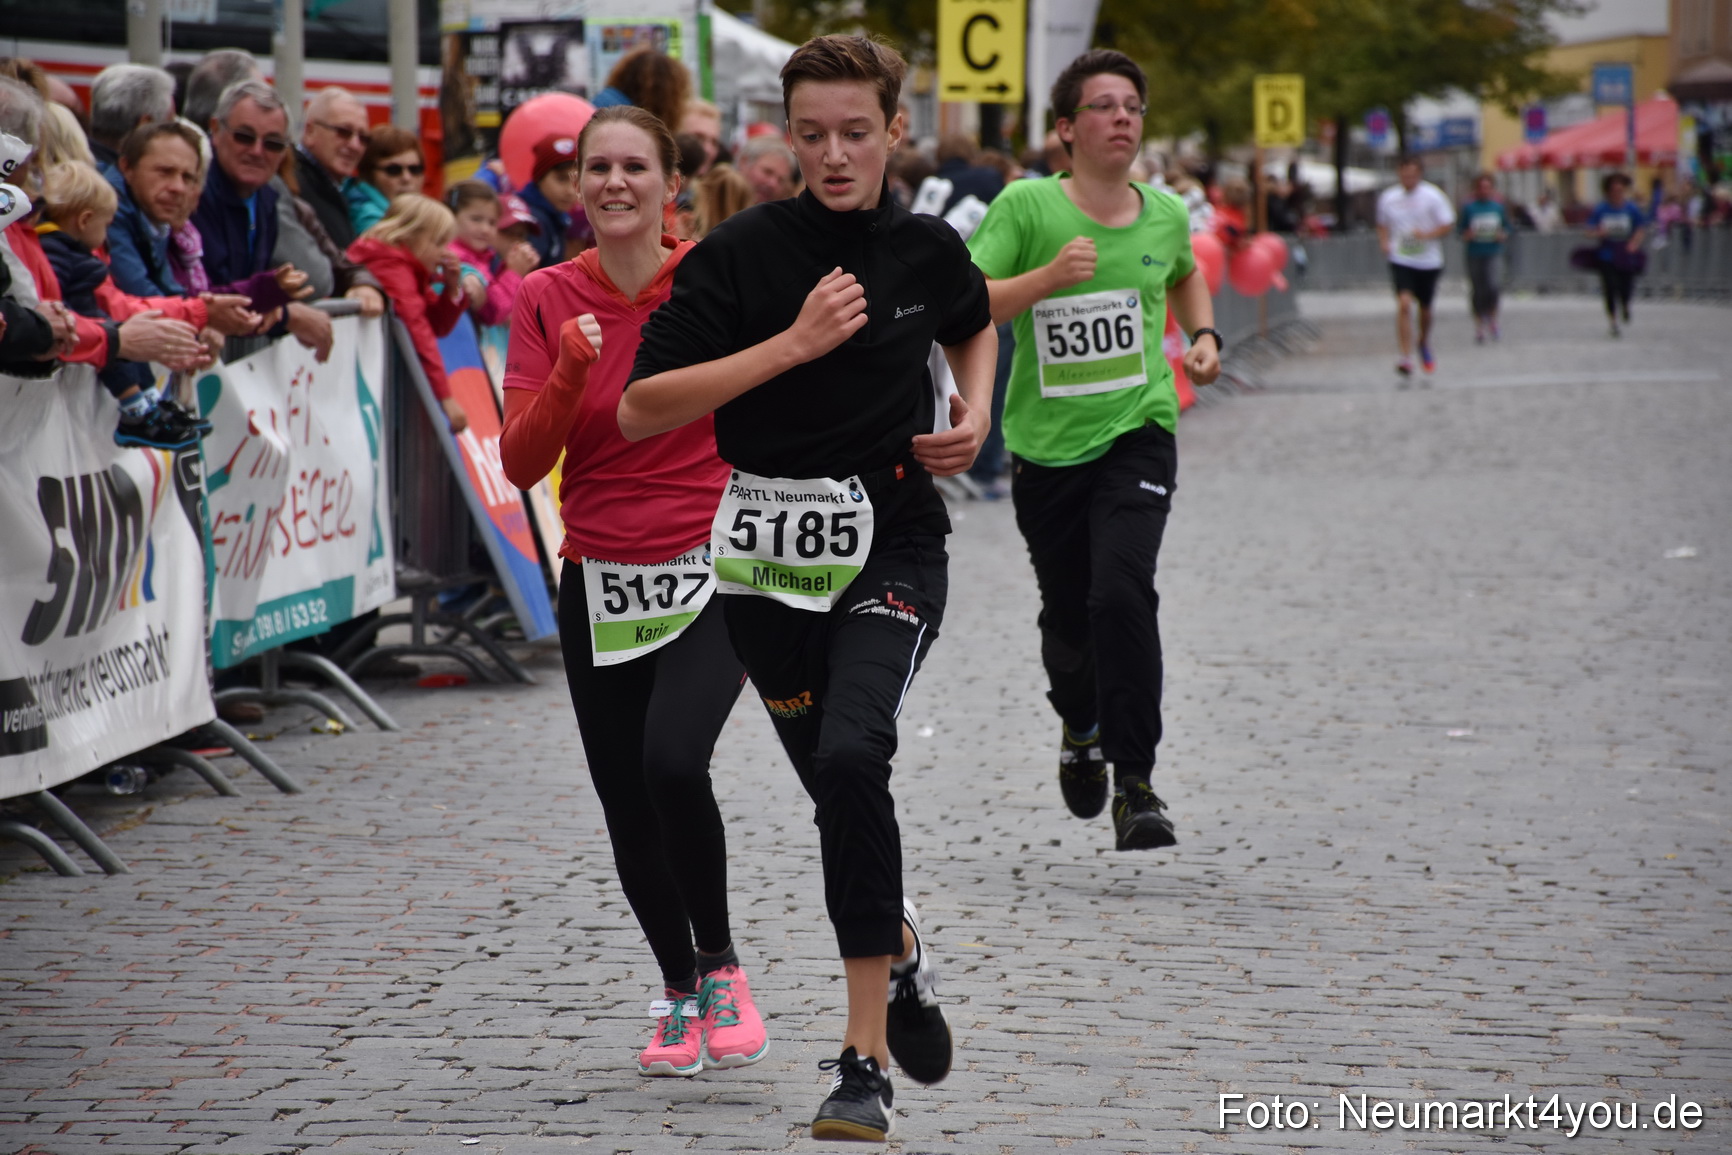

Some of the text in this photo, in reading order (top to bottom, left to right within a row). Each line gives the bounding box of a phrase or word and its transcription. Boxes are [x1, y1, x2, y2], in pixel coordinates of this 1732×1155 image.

[961, 12, 1000, 71] C
[1267, 98, 1293, 132] D
[1035, 301, 1123, 319] PARTL Neumarkt
[1046, 313, 1134, 359] 5306
[728, 484, 846, 504] PARTL Neumarkt
[728, 508, 859, 559] 5185
[600, 571, 710, 615] 5137
[752, 566, 832, 592] Michael
